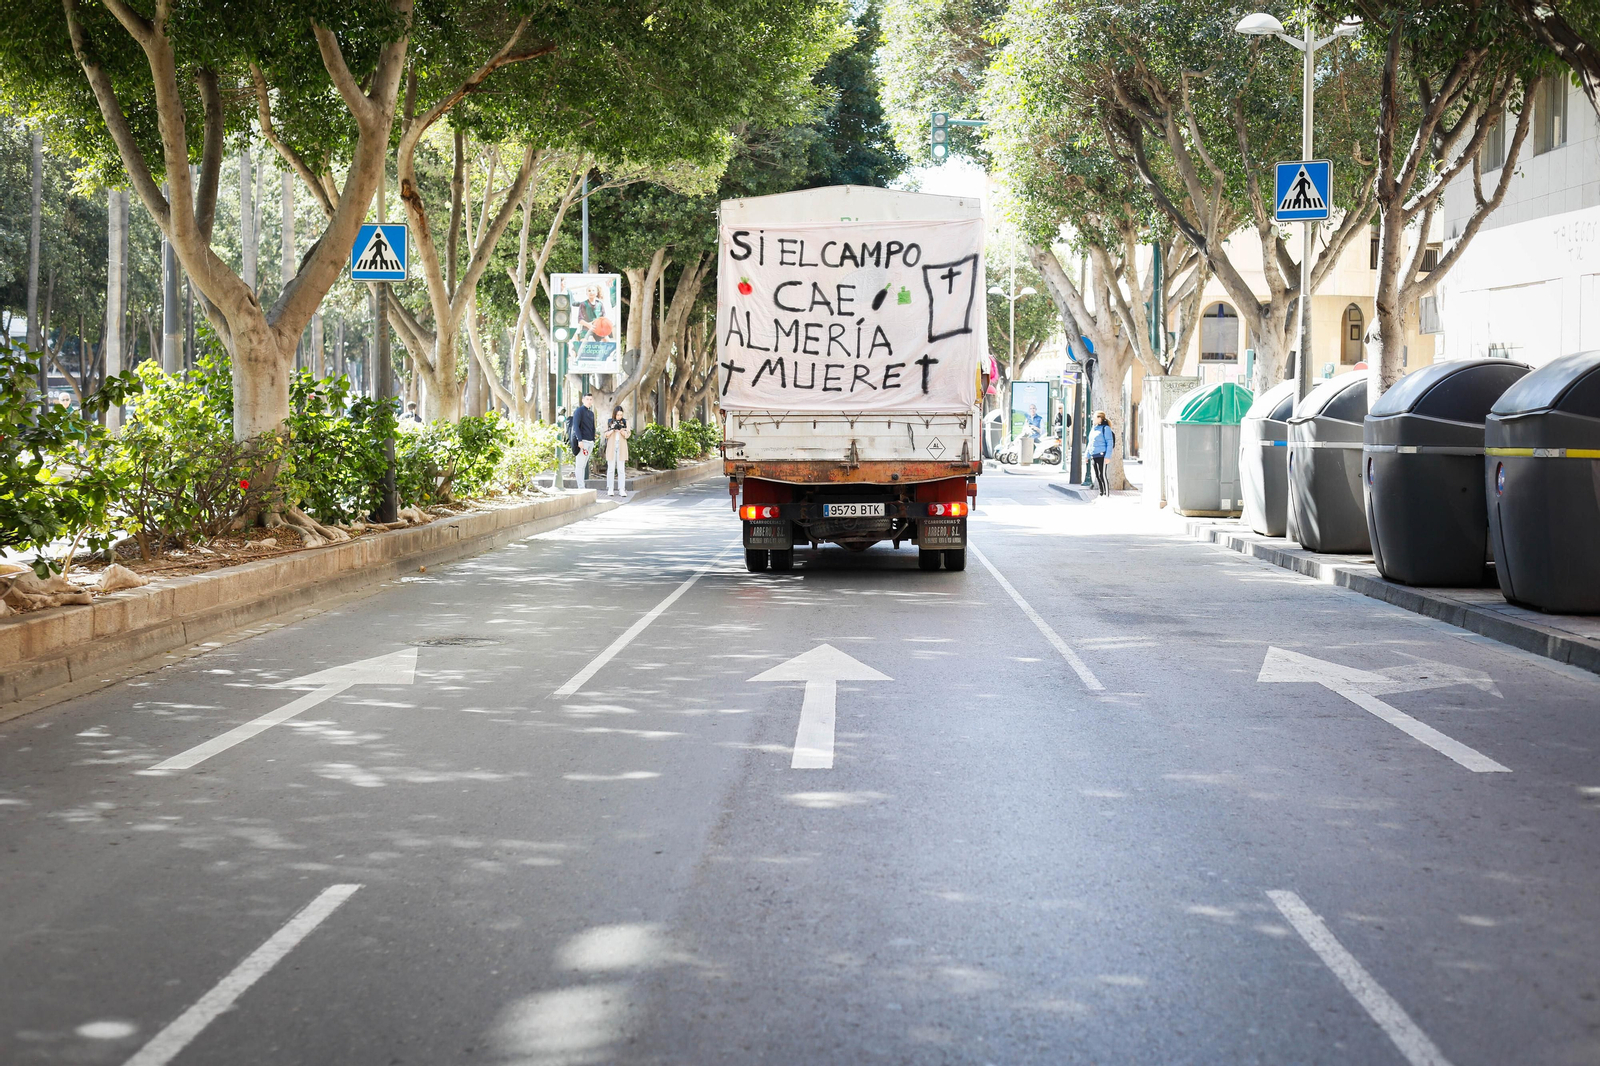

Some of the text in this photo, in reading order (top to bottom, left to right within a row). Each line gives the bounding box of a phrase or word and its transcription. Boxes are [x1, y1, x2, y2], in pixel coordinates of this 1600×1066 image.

[777, 238, 818, 268] EL
[820, 240, 922, 269] CAMPO
[773, 280, 856, 316] CAE
[725, 306, 893, 359] ALMERÍA
[751, 356, 906, 392] MUERE
[830, 504, 857, 516] 9579
[860, 504, 880, 515] BTK
